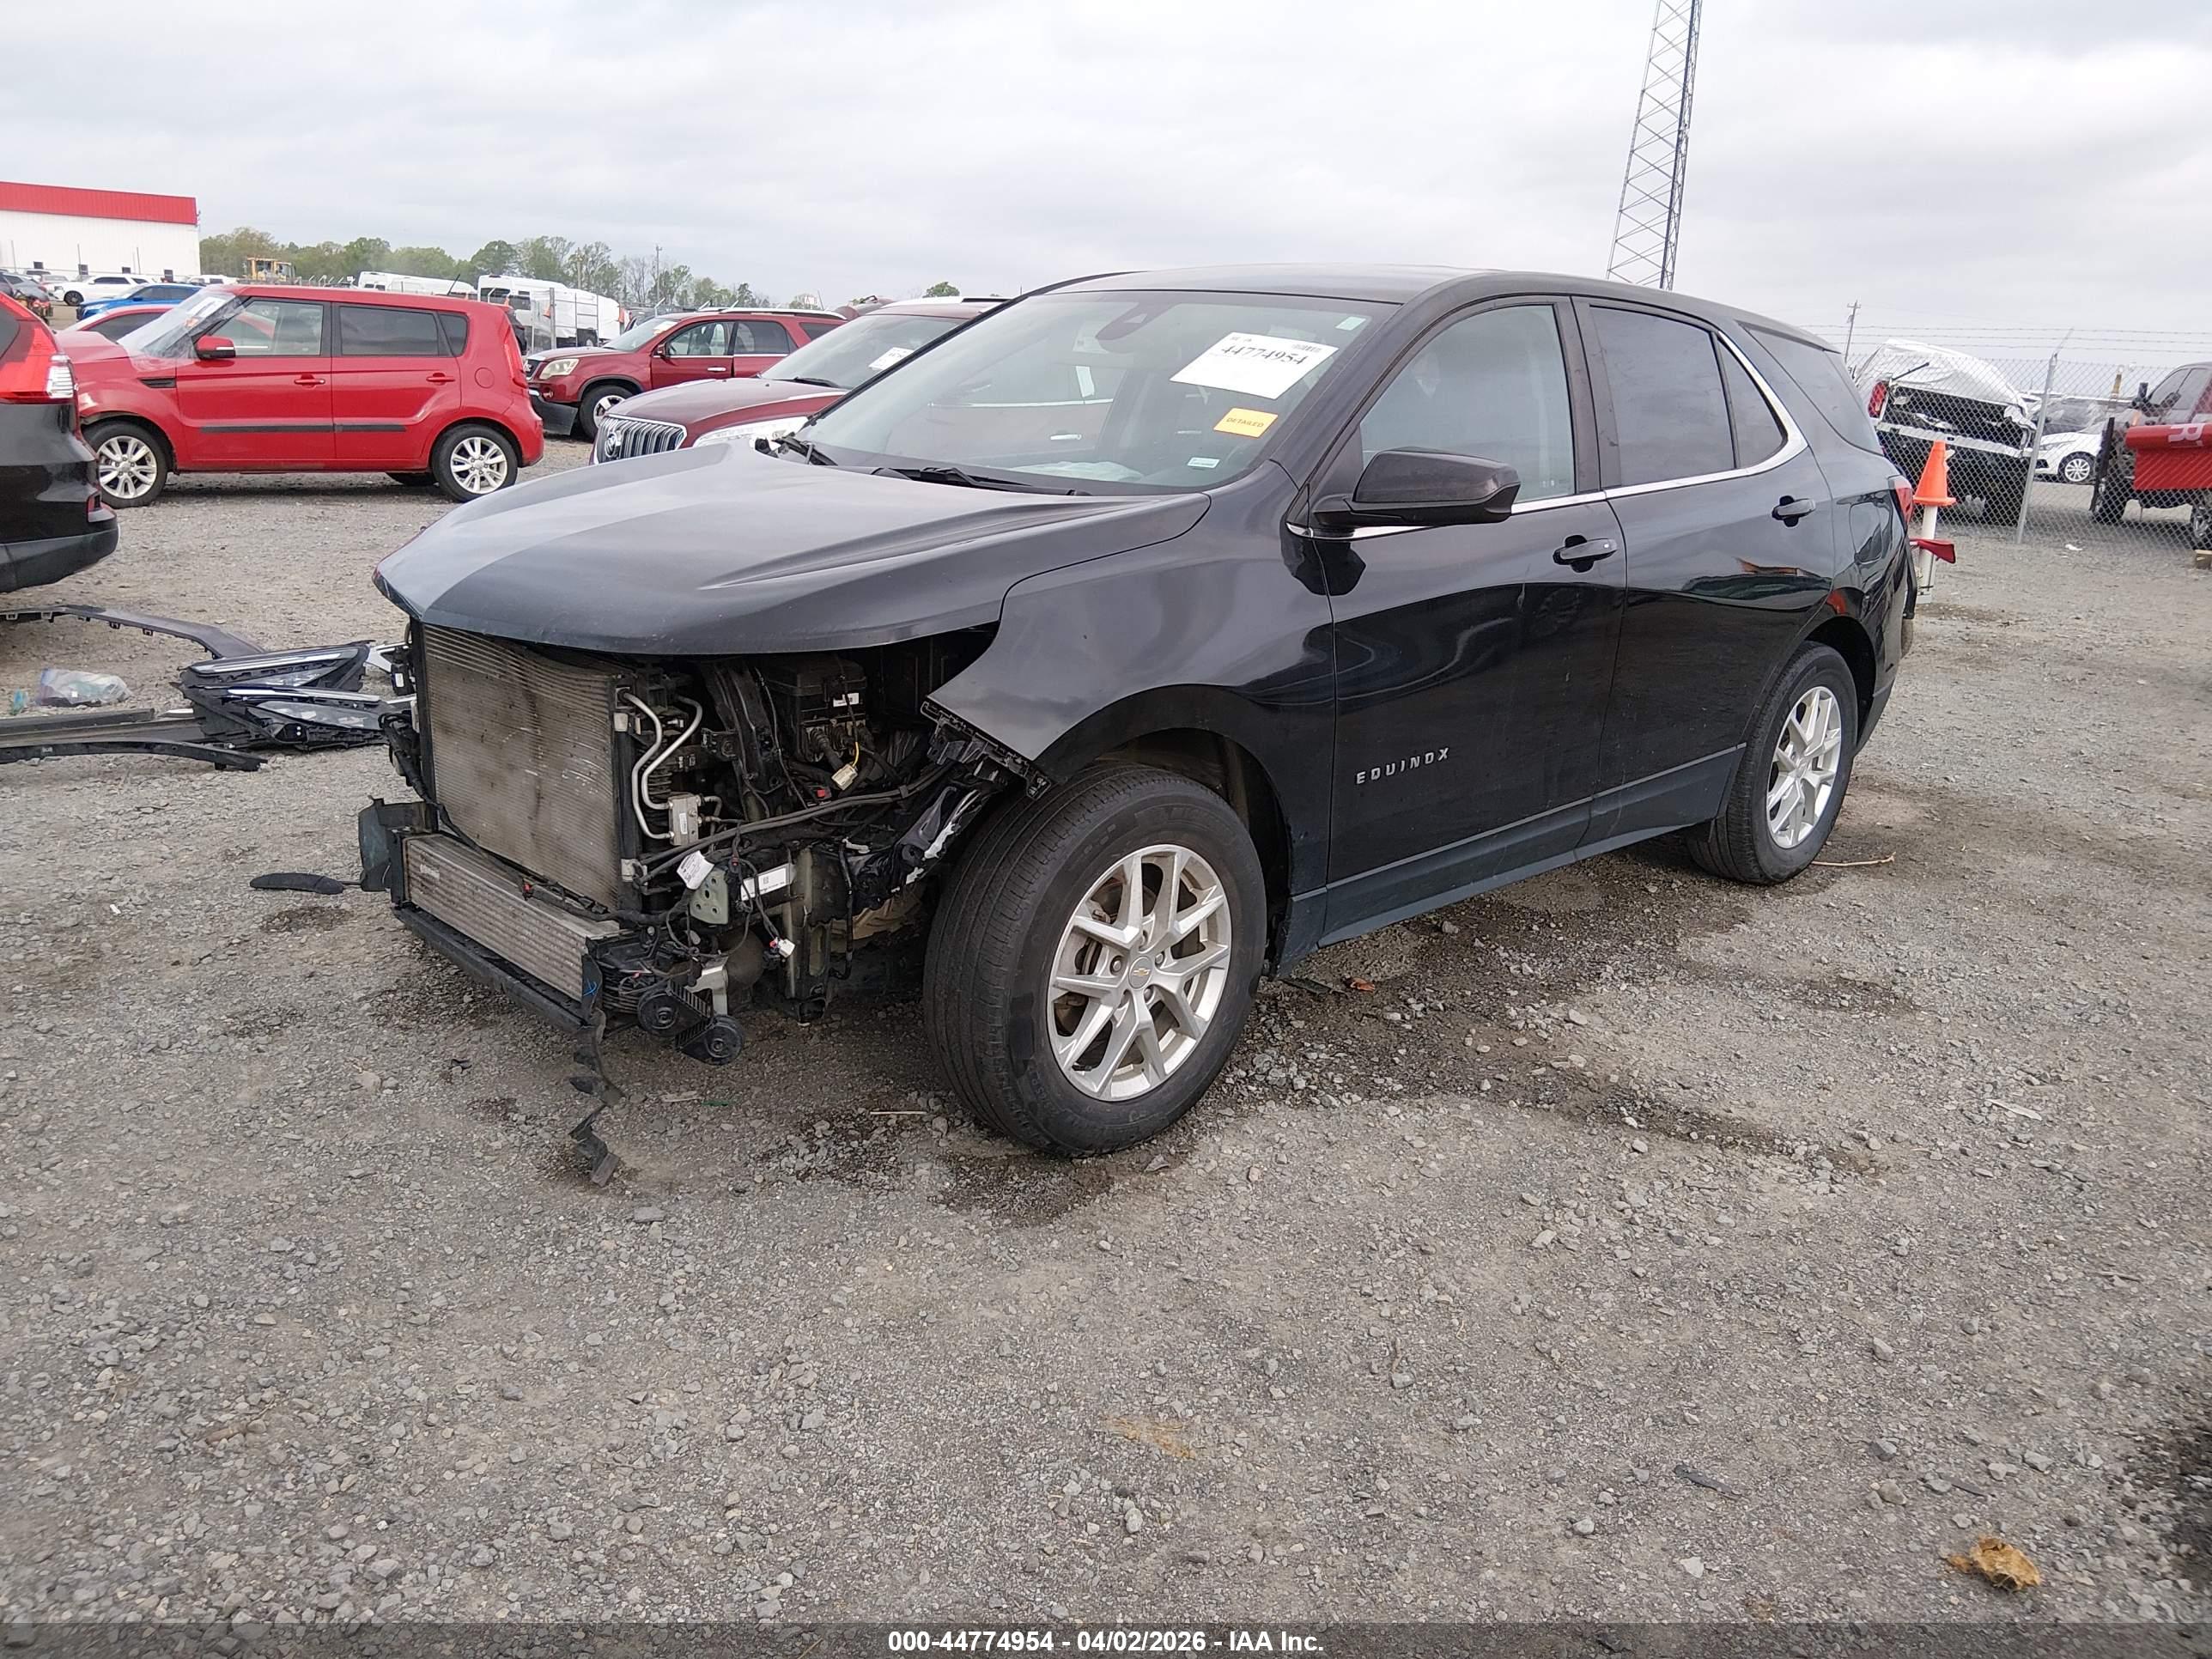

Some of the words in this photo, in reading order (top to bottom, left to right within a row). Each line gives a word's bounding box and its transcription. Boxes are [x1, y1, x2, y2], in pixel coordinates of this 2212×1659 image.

[1221, 345, 1309, 365] 44774954
[1226, 417, 1264, 428] DETAILED
[1356, 747, 1449, 785] EQUINOX
